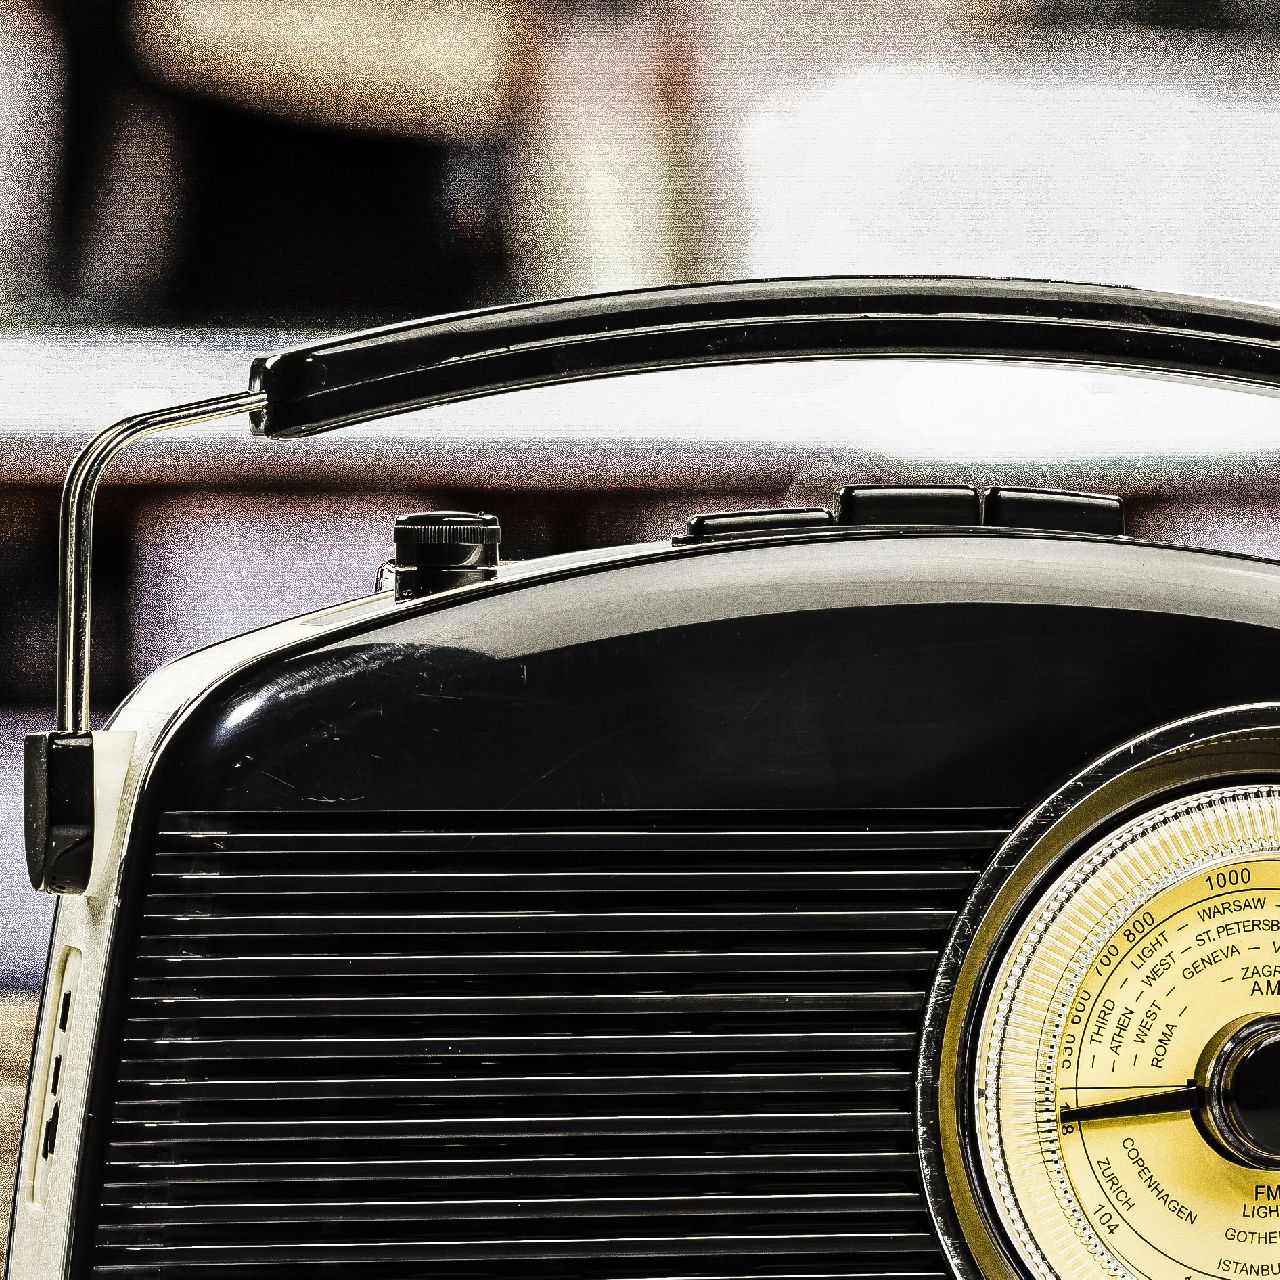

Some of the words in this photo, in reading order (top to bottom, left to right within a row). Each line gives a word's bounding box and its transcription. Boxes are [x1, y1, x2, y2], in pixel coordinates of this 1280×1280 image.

[1123, 912, 1154, 943] 800
[1205, 868, 1250, 890] 1000
[1090, 999, 1115, 1044] THIRD
[1131, 930, 1169, 970] LIGHT
[1197, 897, 1266, 922] WARSAW
[1110, 1007, 1135, 1056] ATHEN
[1141, 951, 1176, 988] WEST
[1133, 1000, 1162, 1043] WEST
[1182, 944, 1240, 980] GENEVA
[1251, 980, 1280, 996] AM
[1151, 1023, 1177, 1069] ROMA
[1060, 1102, 1074, 1135] 18
[1093, 1203, 1120, 1235] 104
[1097, 1157, 1136, 1211] ZURICH
[1122, 1137, 1198, 1224] COPENHAGEN
